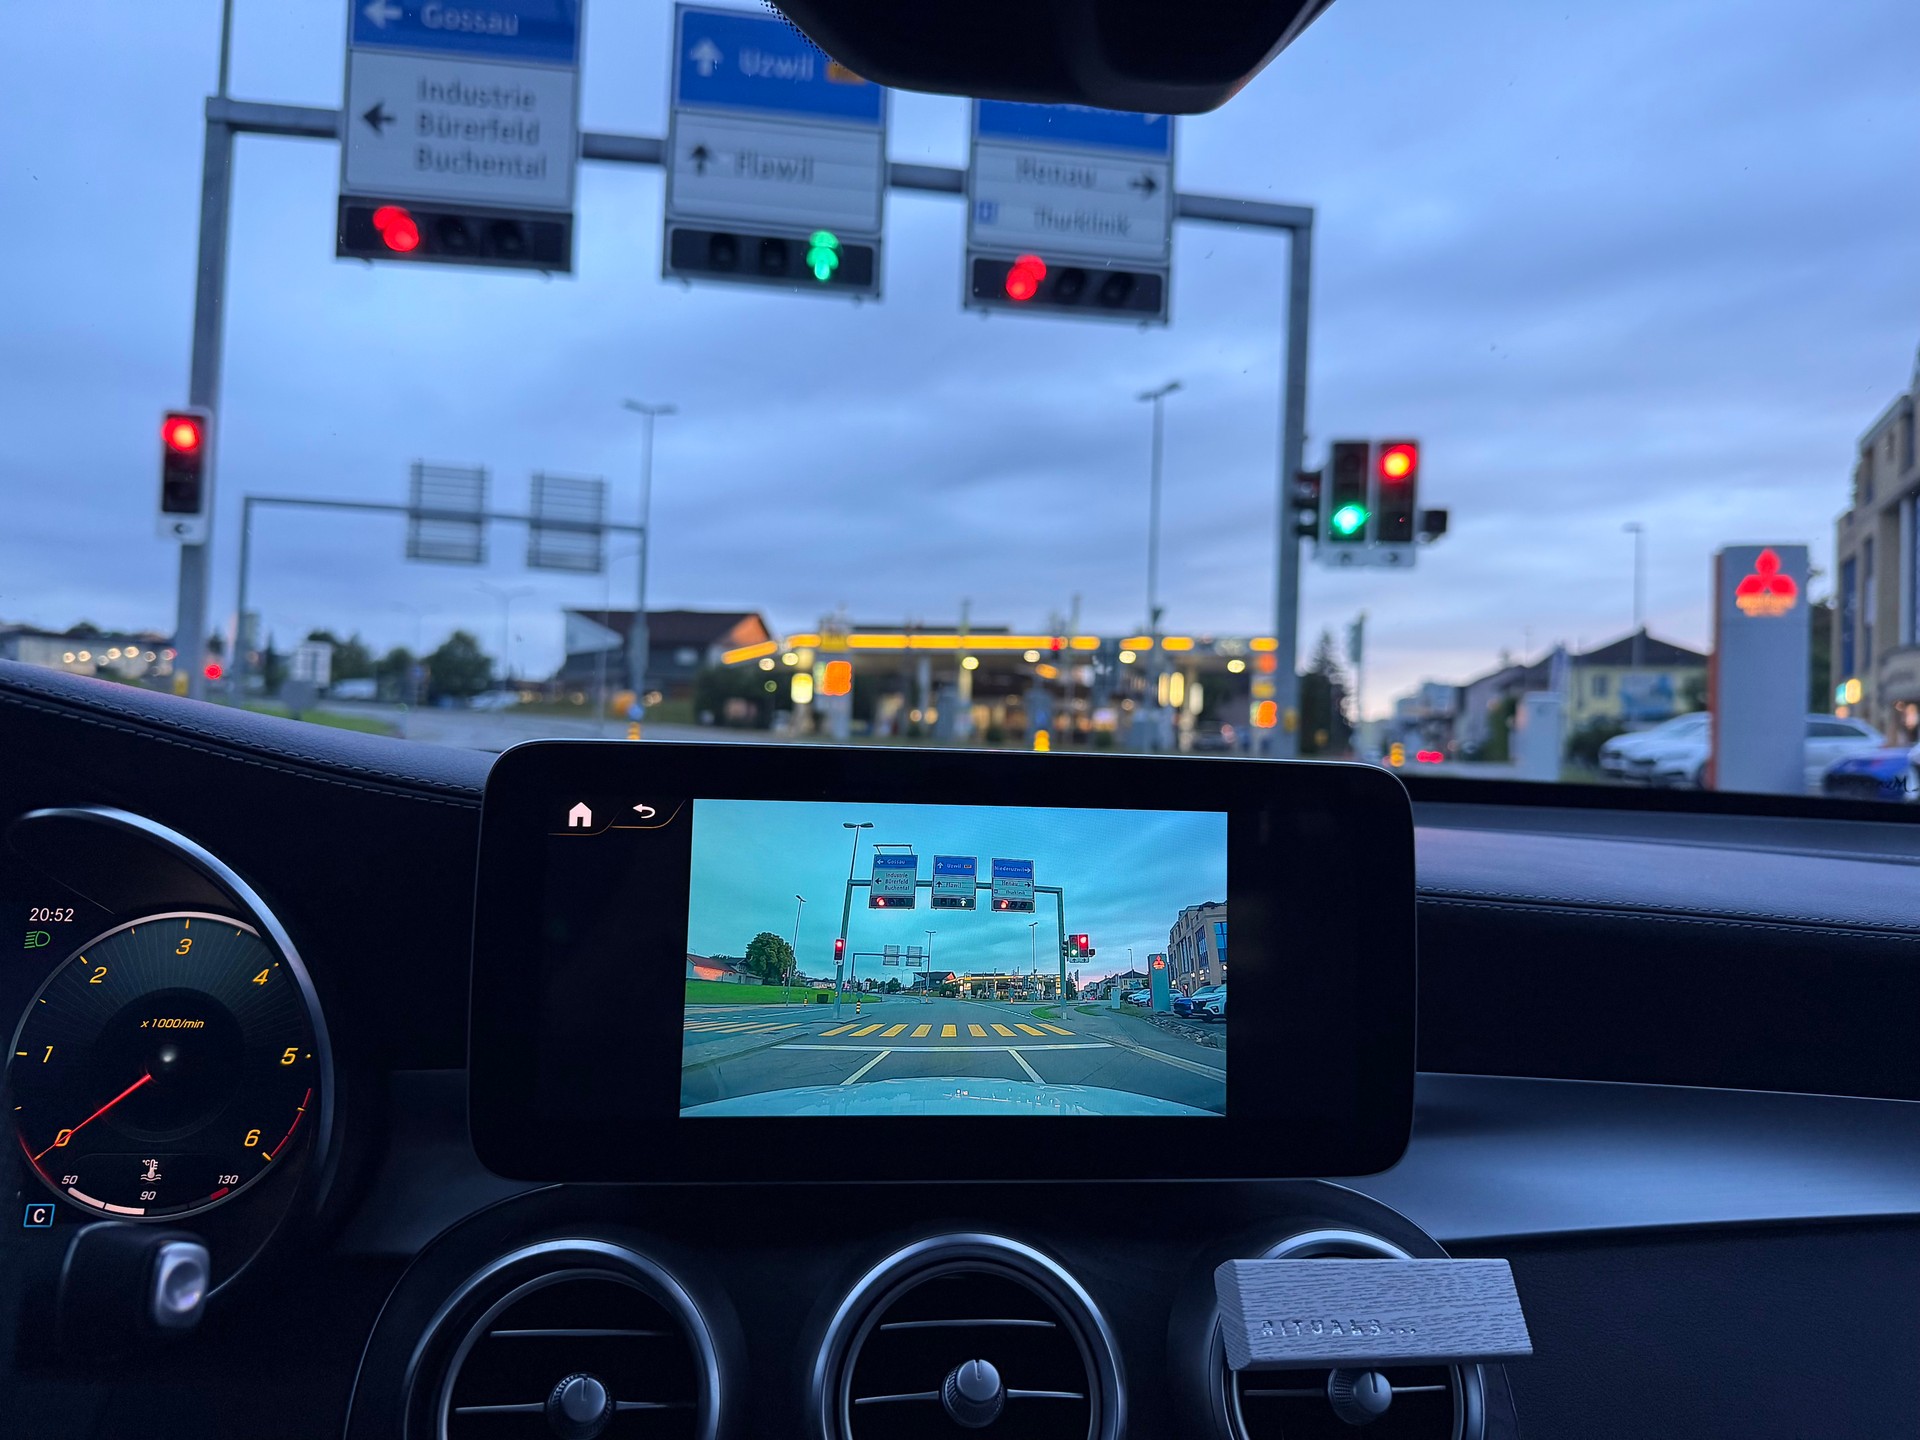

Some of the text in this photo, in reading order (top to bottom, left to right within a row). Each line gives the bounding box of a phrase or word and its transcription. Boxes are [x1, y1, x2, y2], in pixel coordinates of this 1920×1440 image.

[421, 2, 519, 36] Gossau
[738, 48, 815, 82] Uzwil
[417, 75, 537, 112] Industrie
[415, 110, 541, 146] Bürerfeld
[414, 143, 547, 180] Buchental
[735, 149, 815, 184] Flawil
[29, 907, 75, 923] 20:52
[175, 938, 193, 955] 3
[89, 966, 108, 984] 2
[252, 968, 270, 986] 4
[151, 1018, 205, 1029] 1000/min
[42, 1046, 54, 1063] 1
[280, 1047, 299, 1065] 5
[54, 1129, 73, 1147] 0
[243, 1129, 261, 1147] 6
[61, 1175, 79, 1185] 50
[217, 1174, 239, 1185] 130
[140, 1190, 156, 1201] 90
[33, 1208, 46, 1223] C
